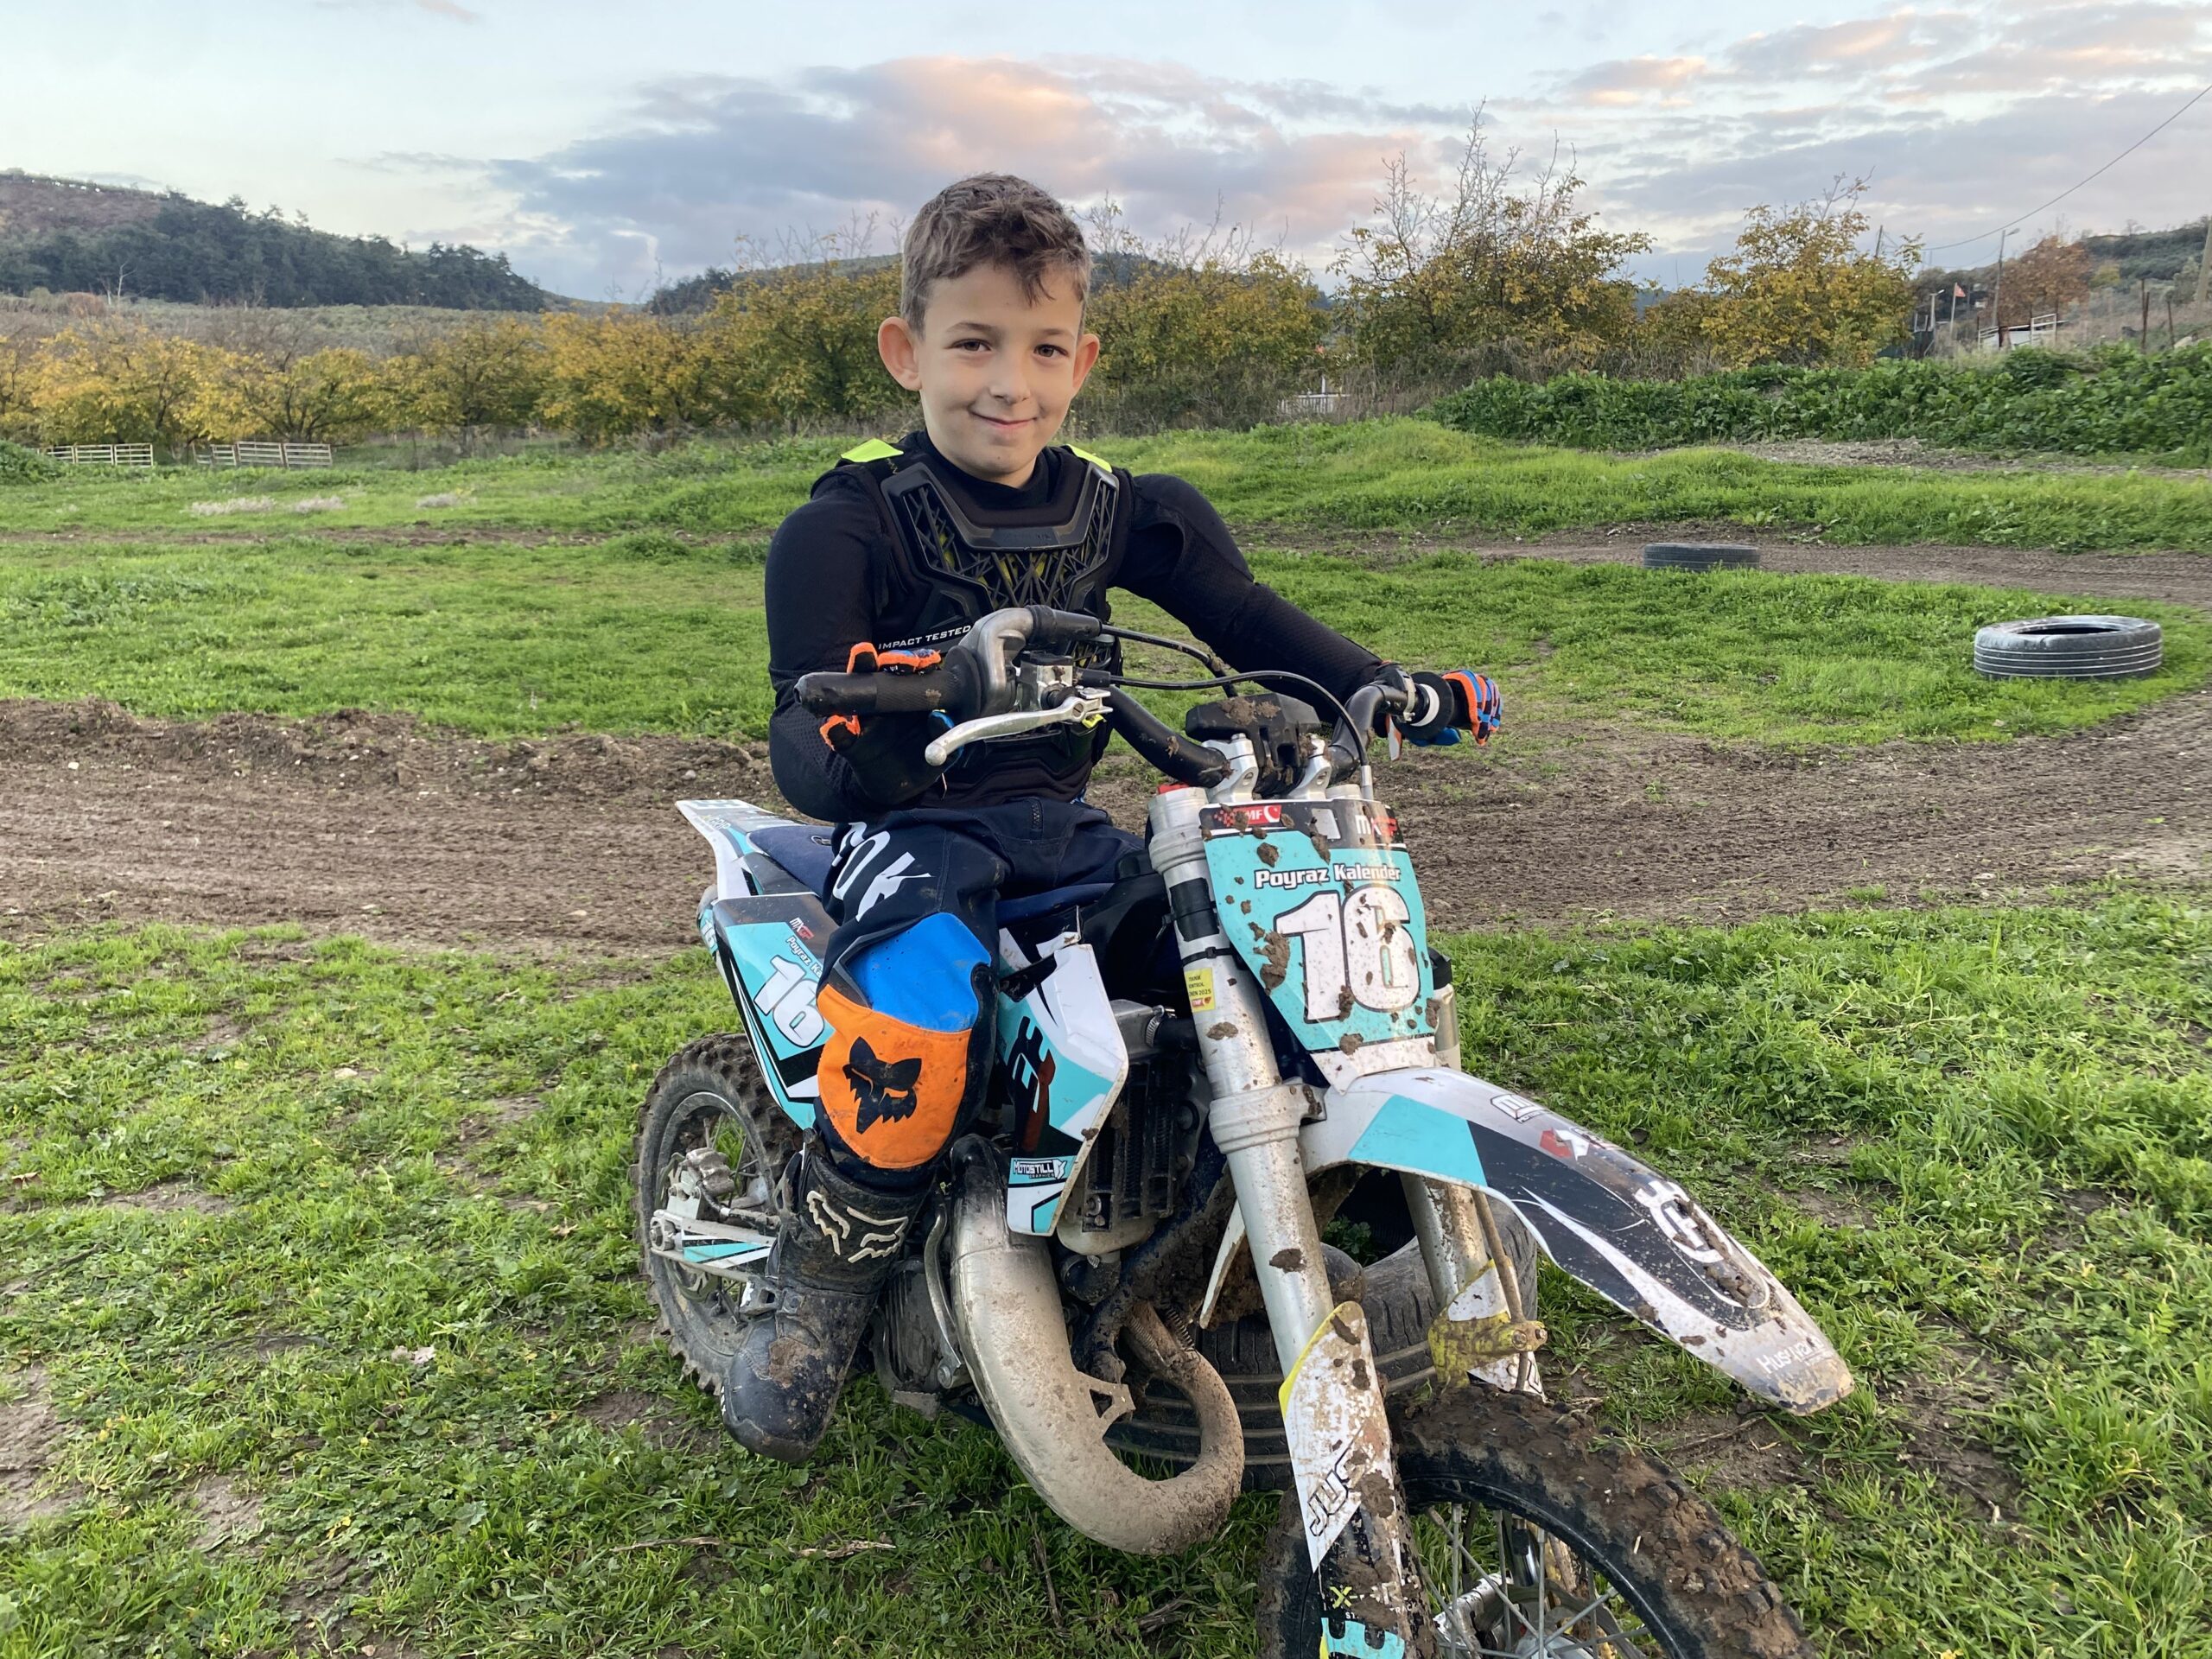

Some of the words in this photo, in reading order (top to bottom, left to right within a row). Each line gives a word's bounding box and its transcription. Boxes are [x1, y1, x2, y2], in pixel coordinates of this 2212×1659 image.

[878, 637, 922, 650] IMPACT
[925, 625, 971, 642] TESTED
[1255, 867, 1330, 889] Poyraz
[1332, 862, 1402, 882] Kalender
[785, 934, 813, 966] Poyraz
[1274, 883, 1422, 1024] 16
[753, 954, 825, 1047] 16
[1013, 1160, 1054, 1175] MOTOSTILL
